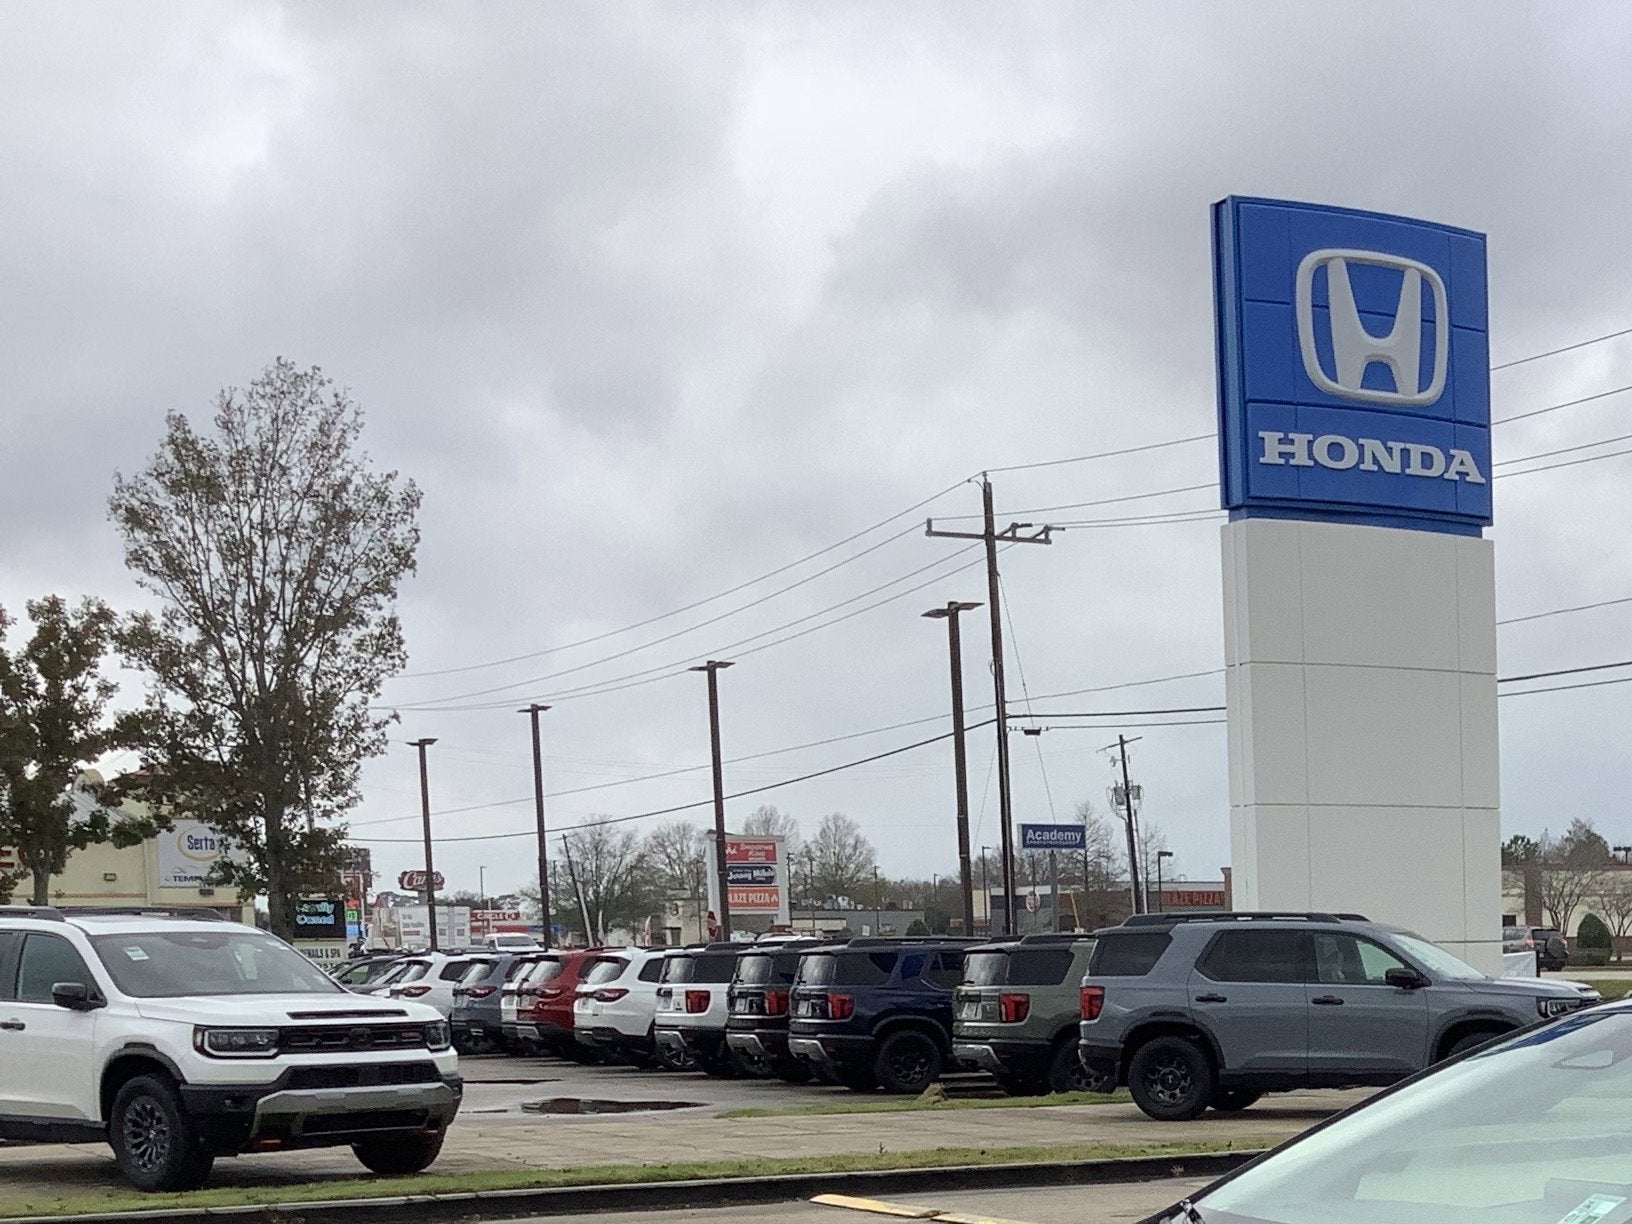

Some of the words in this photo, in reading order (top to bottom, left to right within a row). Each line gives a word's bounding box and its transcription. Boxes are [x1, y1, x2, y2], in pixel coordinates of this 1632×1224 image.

[1258, 431, 1486, 484] HONDA
[187, 834, 216, 850] Serta
[1026, 829, 1082, 844] Academy
[728, 892, 748, 904] LAZE
[748, 892, 770, 904] PIZZA
